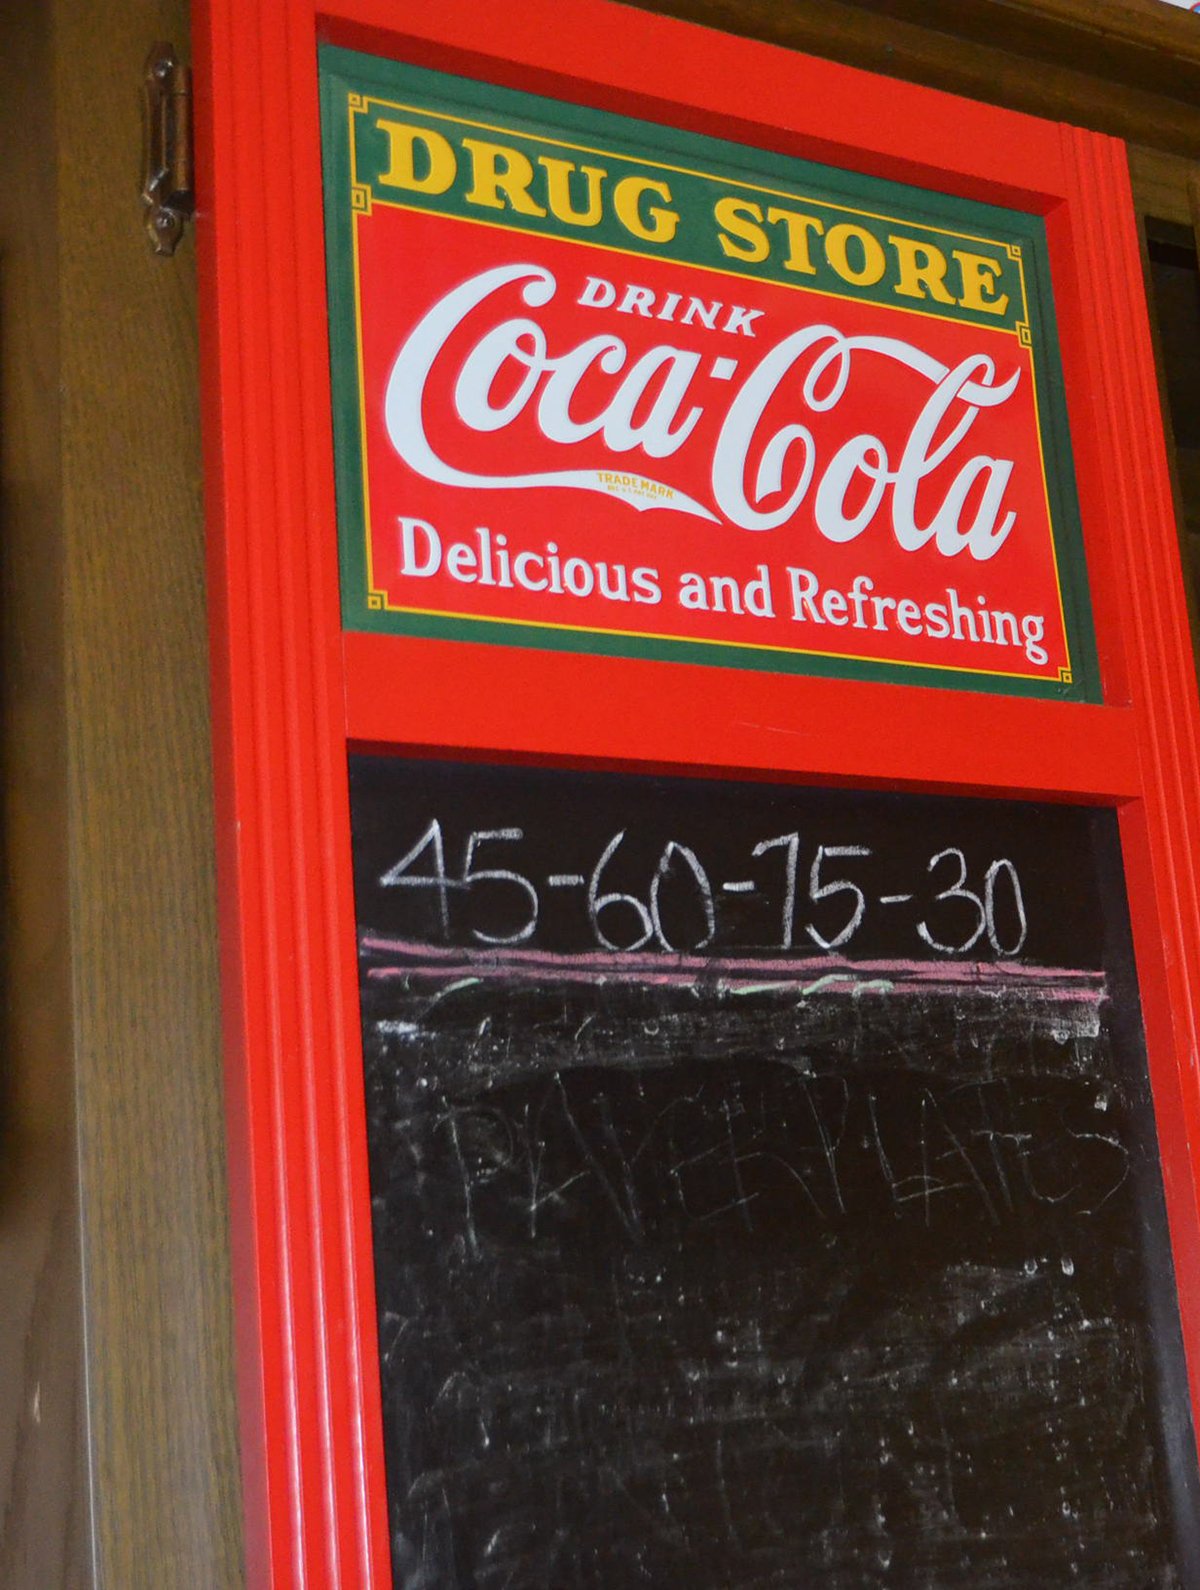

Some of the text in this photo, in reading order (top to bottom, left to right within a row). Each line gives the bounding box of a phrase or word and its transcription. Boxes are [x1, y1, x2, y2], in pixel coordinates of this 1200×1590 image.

[375, 118, 1011, 315] DRUG STORE
[576, 276, 767, 337] DRINK
[384, 263, 1021, 560] Coca-Cola
[597, 471, 639, 489] TRADE
[398, 516, 1051, 665] Delicious and Refreshing
